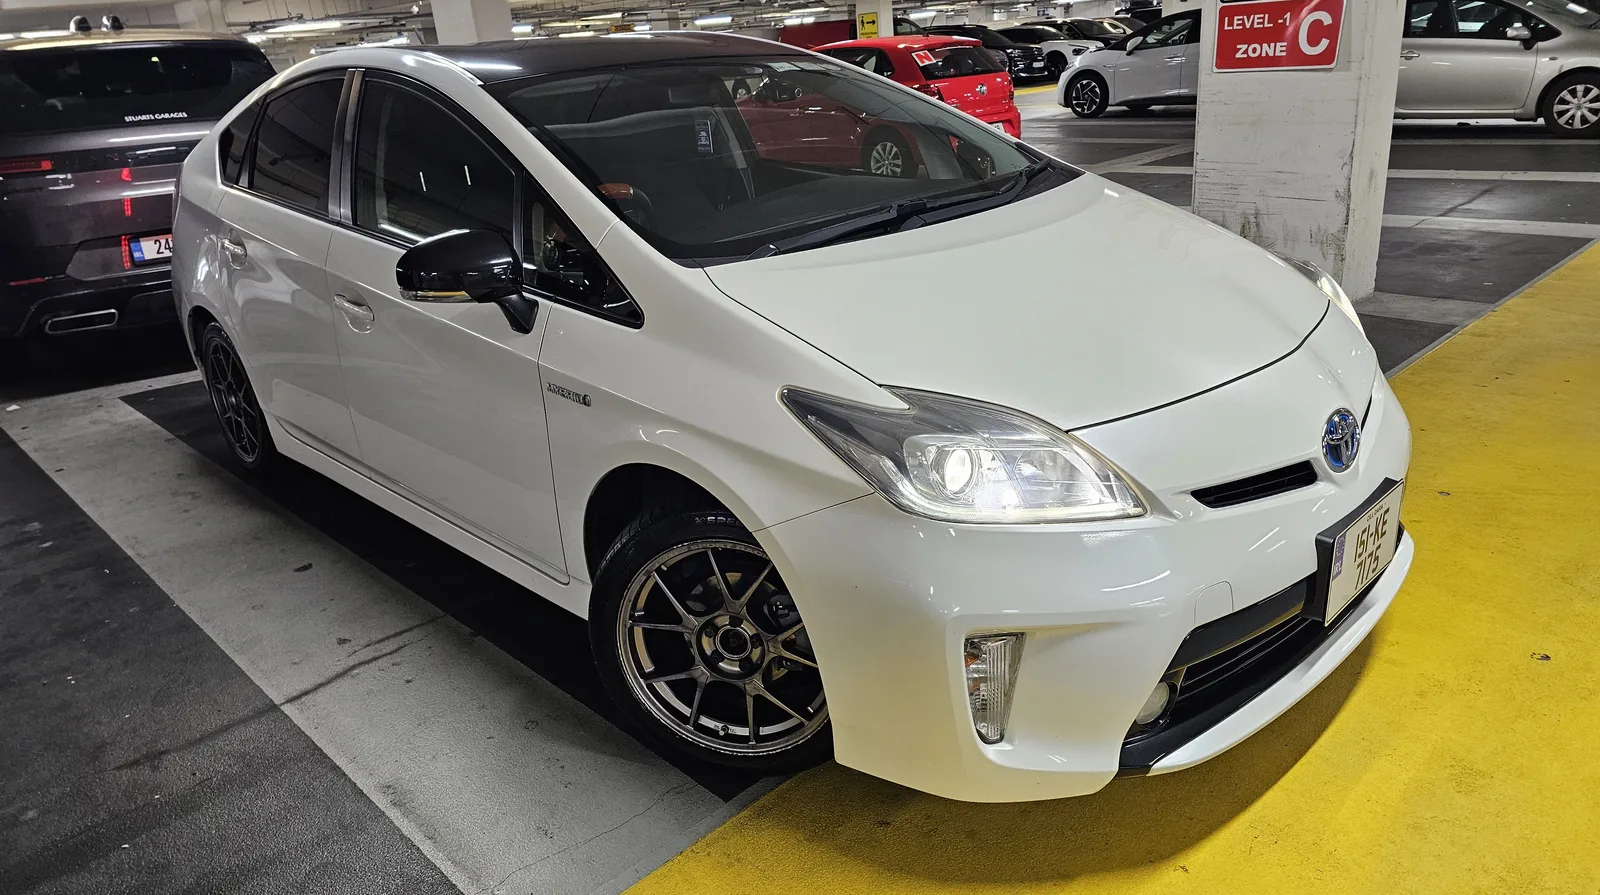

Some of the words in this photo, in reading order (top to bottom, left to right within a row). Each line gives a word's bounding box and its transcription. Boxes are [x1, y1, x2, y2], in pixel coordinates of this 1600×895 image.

[1224, 14, 1273, 30] LEVEL
[1277, 12, 1291, 26] -1
[1298, 10, 1333, 55] C
[914, 51, 933, 65] N
[1235, 42, 1287, 58] ZONE
[124, 113, 155, 122] STUARTS
[154, 111, 188, 120] GARAGES
[154, 238, 172, 255] 24
[1354, 507, 1390, 563] 151-KE
[1355, 543, 1381, 590] 7175
